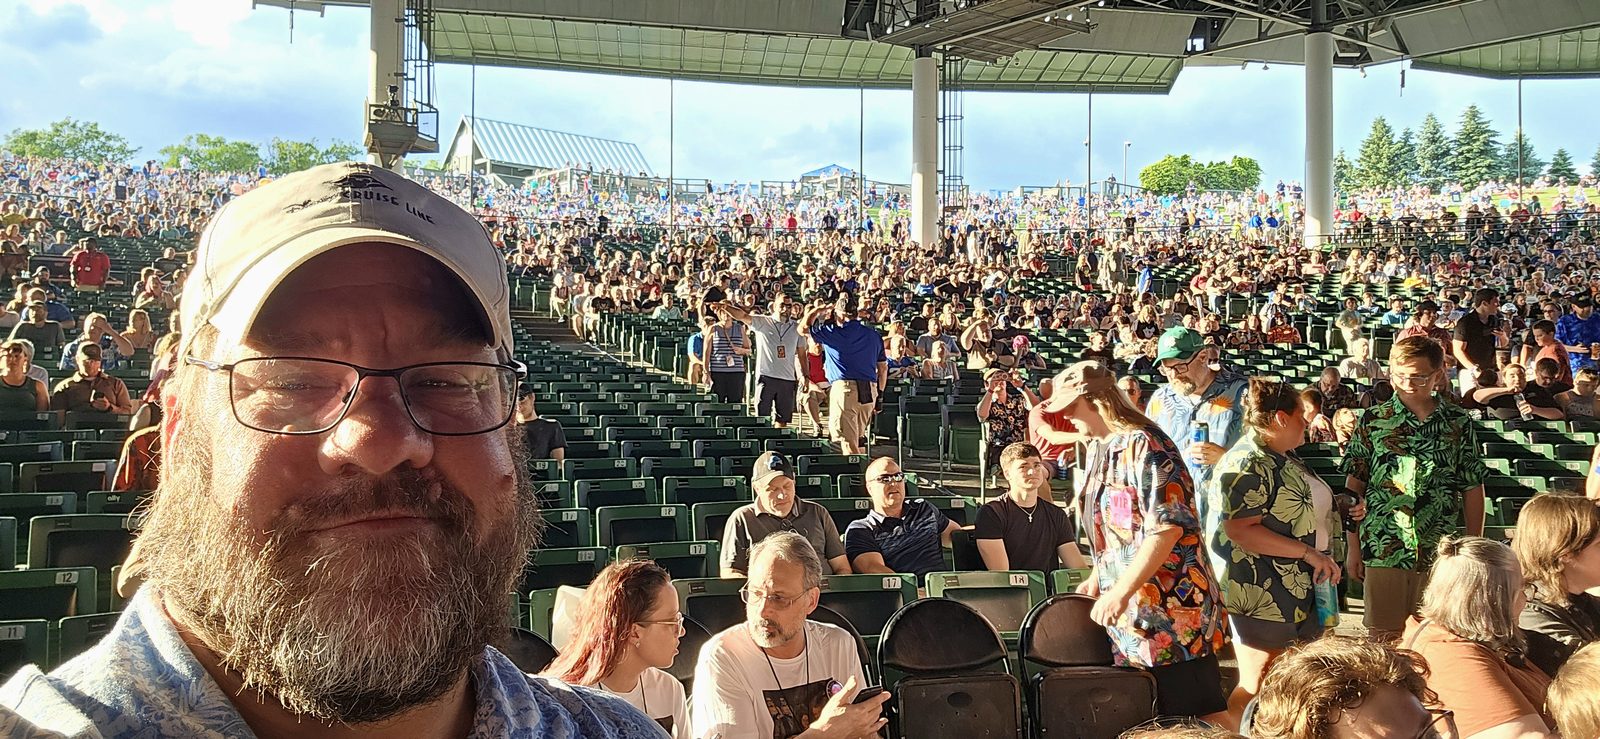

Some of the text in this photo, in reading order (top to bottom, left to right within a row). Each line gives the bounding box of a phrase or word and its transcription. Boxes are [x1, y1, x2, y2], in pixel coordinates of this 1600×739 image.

[341, 190, 399, 206] CRUISE
[405, 202, 436, 225] LINE
[693, 545, 703, 554] 17
[61, 572, 73, 583] 12
[886, 577, 897, 588] 17
[7, 627, 17, 638] 11
